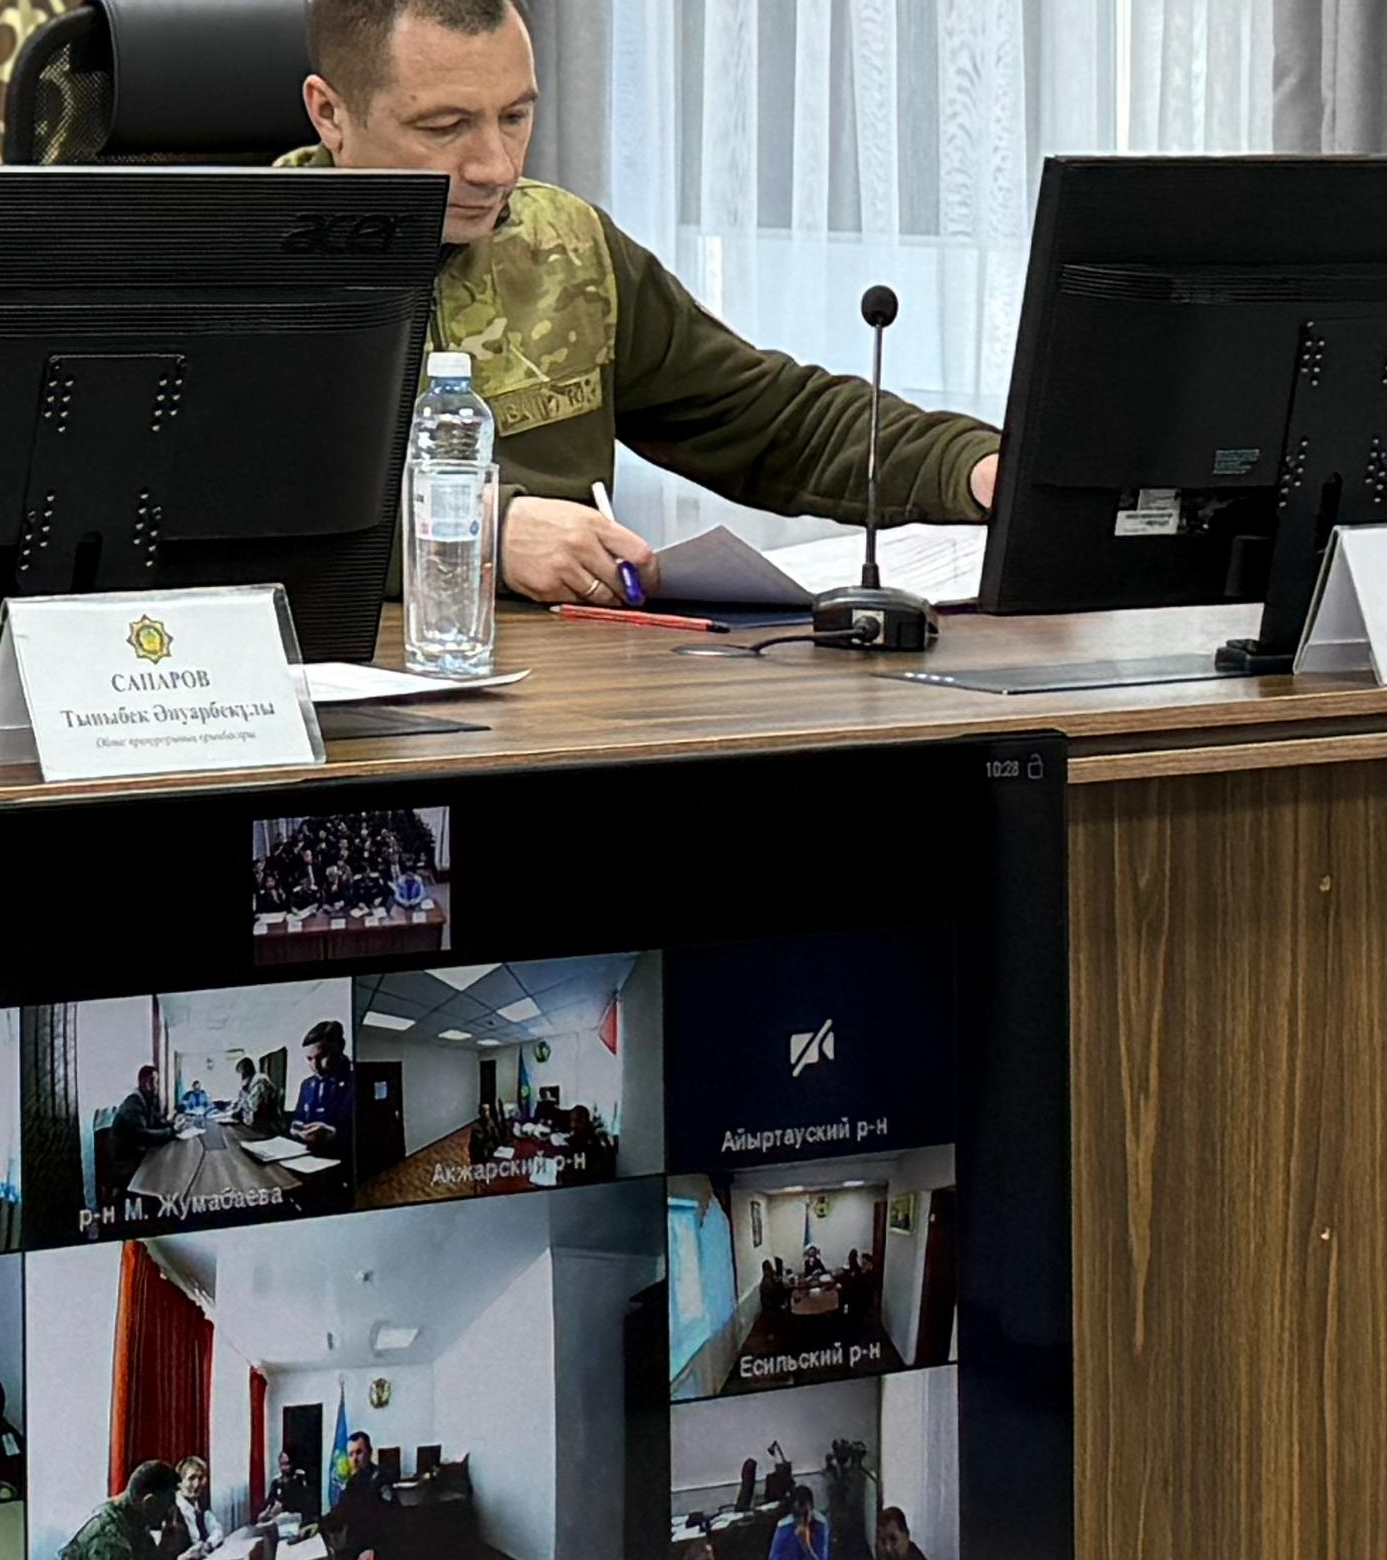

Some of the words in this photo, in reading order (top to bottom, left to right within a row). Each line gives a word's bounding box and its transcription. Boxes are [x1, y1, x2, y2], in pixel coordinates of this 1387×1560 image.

[111, 670, 210, 692] САПАРОВ
[721, 1116, 850, 1153] Айыртауский
[856, 1117, 888, 1142] р-н
[430, 1150, 548, 1187] Акжарский
[79, 1205, 115, 1233] р-н
[125, 1196, 149, 1222] М.
[157, 1186, 284, 1221] Жумабаева
[740, 1341, 843, 1378] Есильский
[849, 1342, 881, 1368] р-н
